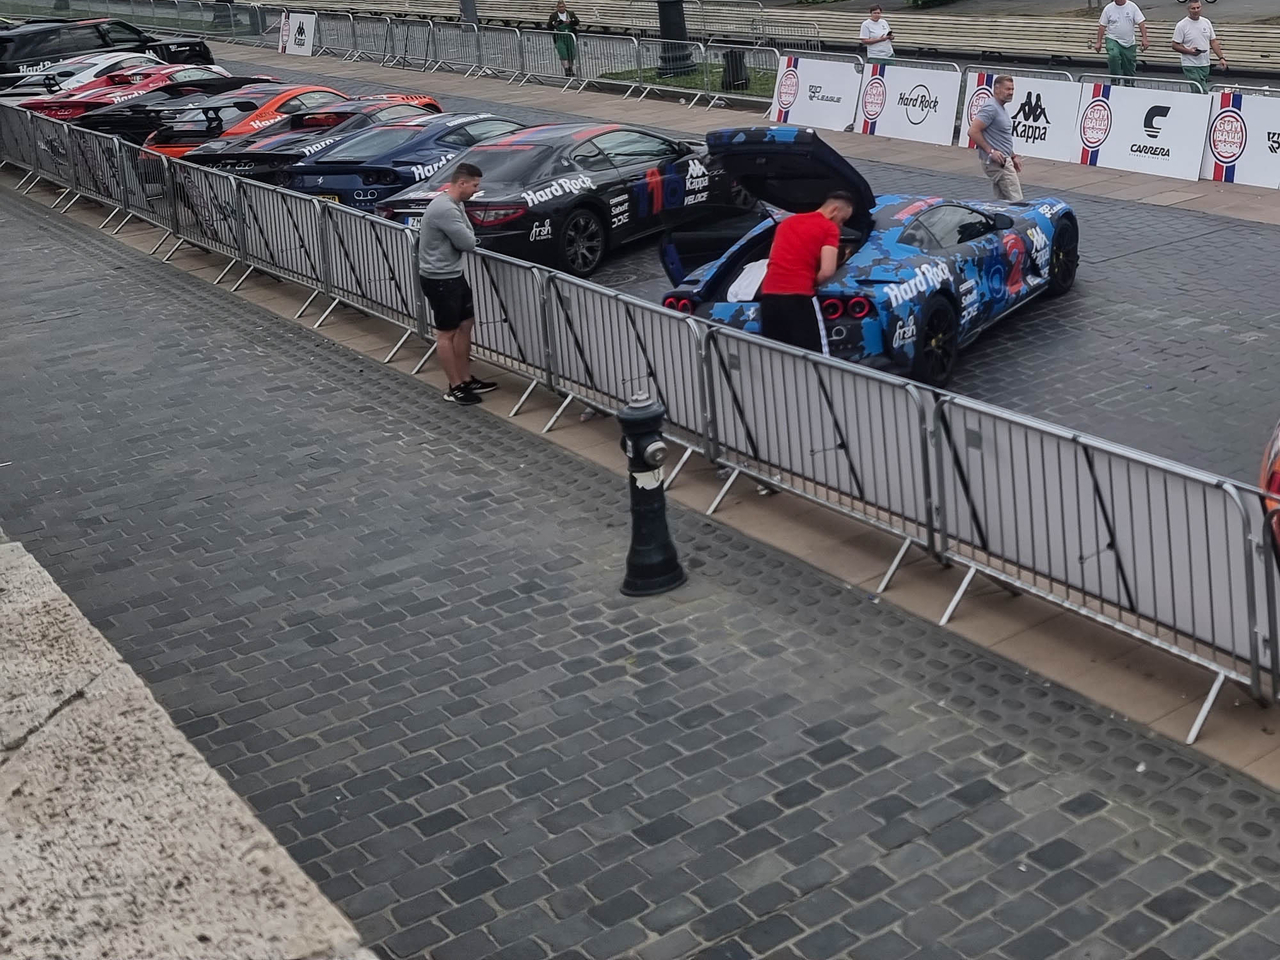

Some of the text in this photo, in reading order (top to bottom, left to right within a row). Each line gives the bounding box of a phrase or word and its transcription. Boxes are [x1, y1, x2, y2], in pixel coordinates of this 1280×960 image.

[897, 92, 939, 113] Hard Rock
[1086, 108, 1107, 120] GUM
[1011, 120, 1048, 143] Kappa
[1084, 119, 1107, 130] BALL
[1215, 119, 1241, 132] GUM
[1214, 130, 1242, 142] BALL
[1130, 143, 1170, 157] CARRERA
[521, 174, 598, 208] Hard Rock
[685, 176, 709, 191] Kappa
[683, 191, 709, 207] VELOCE
[529, 218, 552, 242] frsh
[882, 266, 925, 308] Hard
[920, 259, 955, 290] Rock
